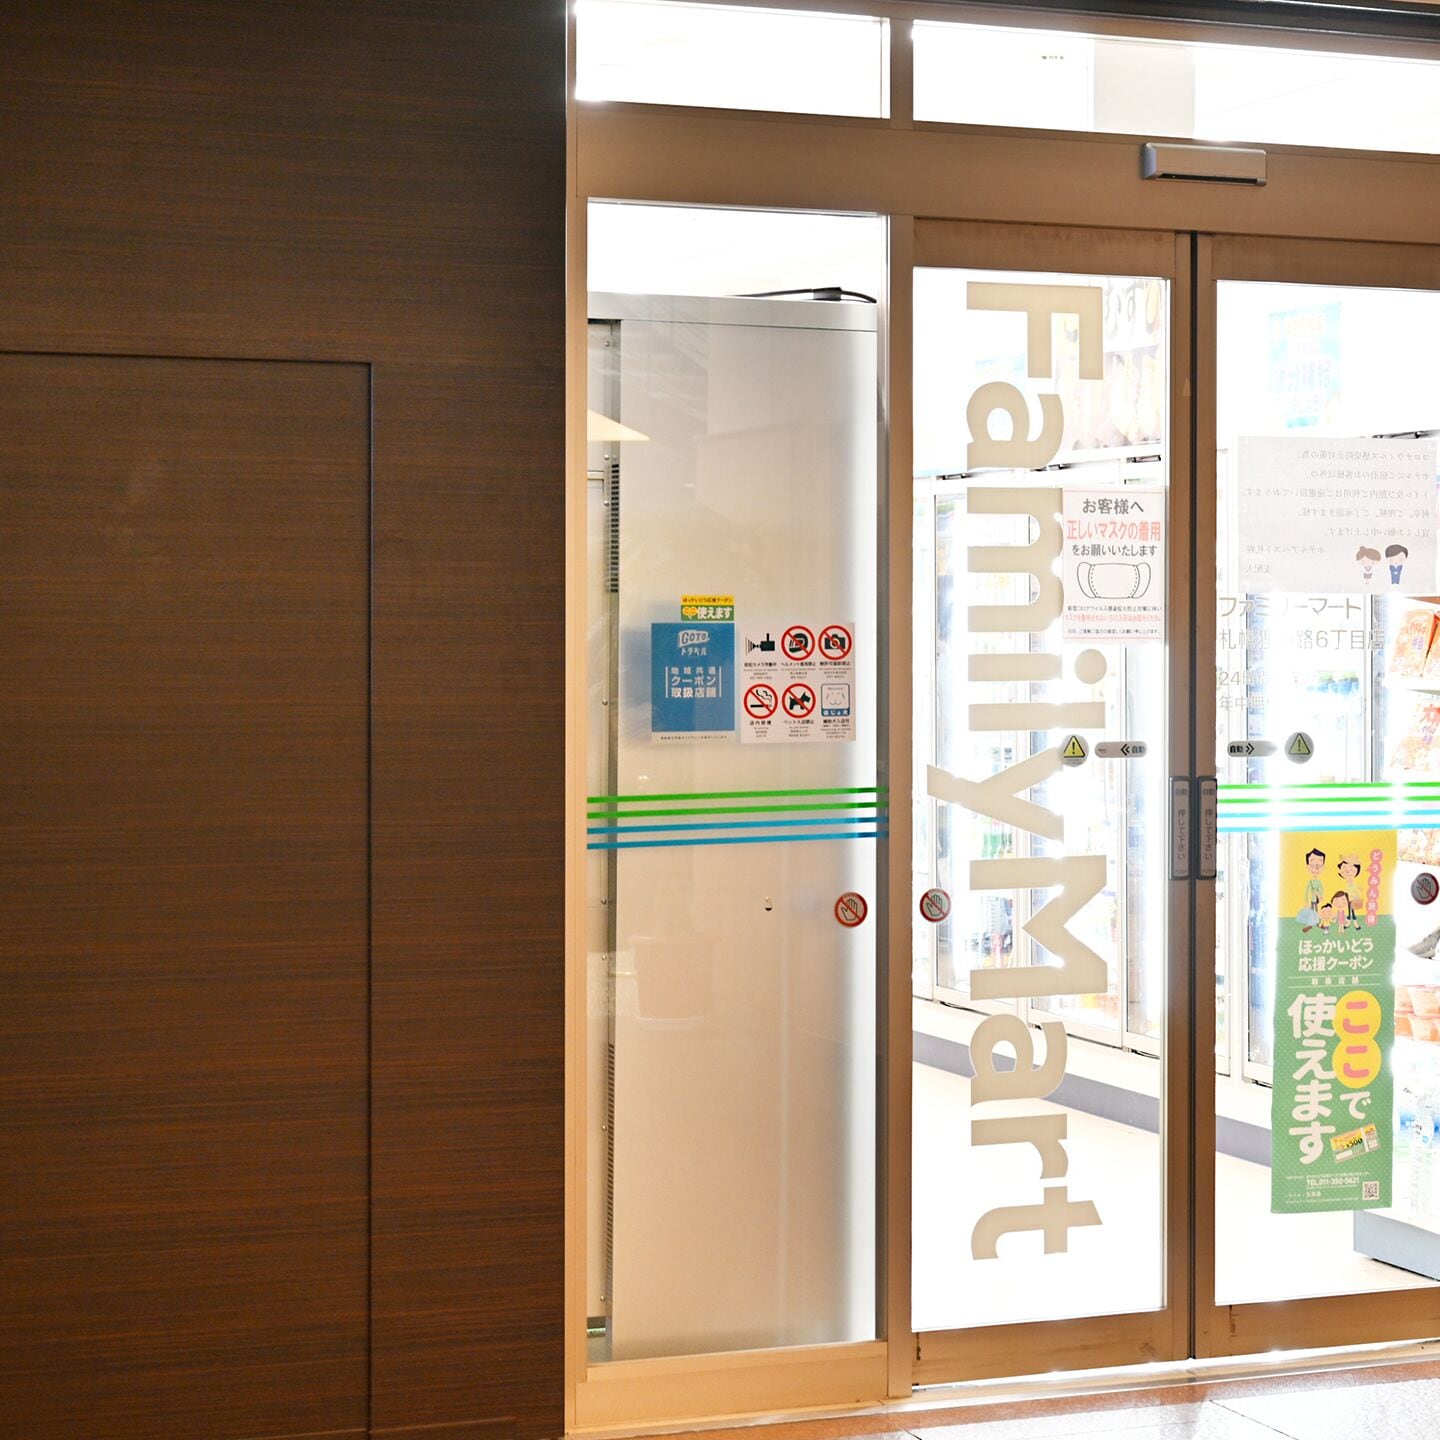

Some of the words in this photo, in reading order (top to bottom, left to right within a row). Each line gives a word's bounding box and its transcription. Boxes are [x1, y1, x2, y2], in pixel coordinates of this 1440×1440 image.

[1082, 498, 1144, 515] お客様へ
[1066, 520, 1161, 542] 正しいマスクの着用
[1072, 544, 1158, 557] をお願いいたします
[697, 606, 733, 619] 使えます
[1219, 628, 1385, 650] 札幌狸路6丁目店
[681, 647, 707, 656] トラベル
[671, 676, 717, 686] クーポン
[927, 281, 1107, 1261] FamilyMart
[1298, 937, 1374, 955] ほっかいどう
[1298, 955, 1374, 972] 応援クーポン
[1340, 1000, 1372, 1120] ここで
[1287, 992, 1338, 1165] 使えます
